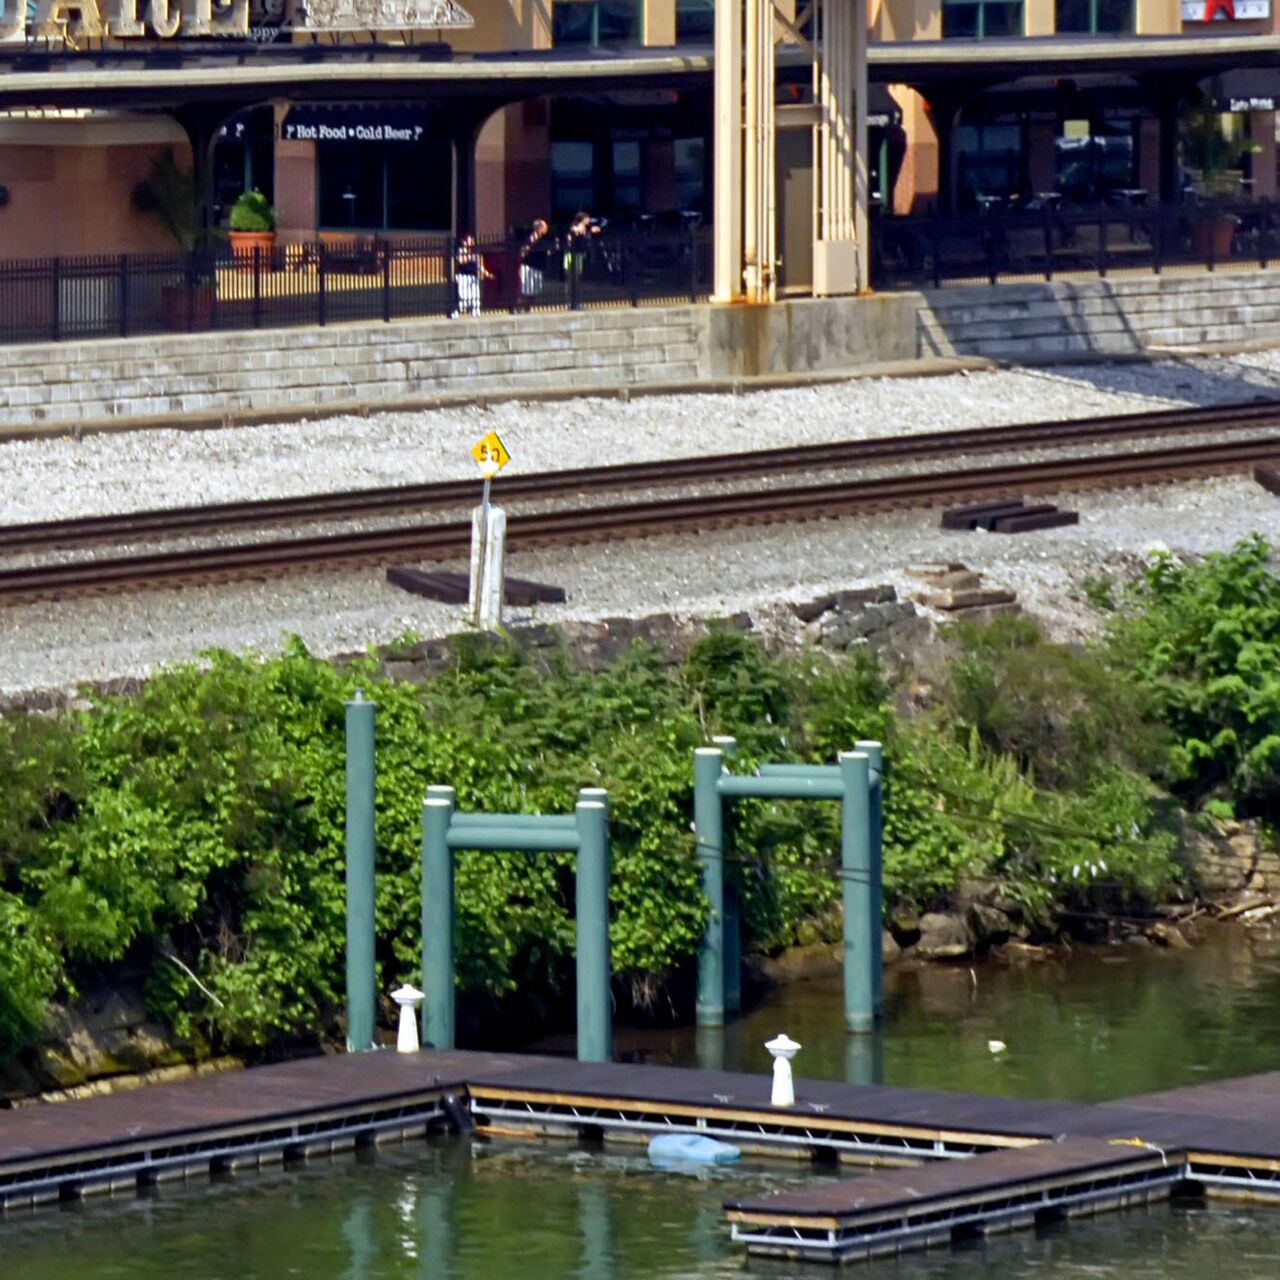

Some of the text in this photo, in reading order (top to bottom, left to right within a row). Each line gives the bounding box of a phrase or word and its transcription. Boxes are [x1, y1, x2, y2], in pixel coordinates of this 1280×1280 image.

[297, 125, 412, 140] Hot Food Cold Beer
[479, 444, 501, 463] 50
